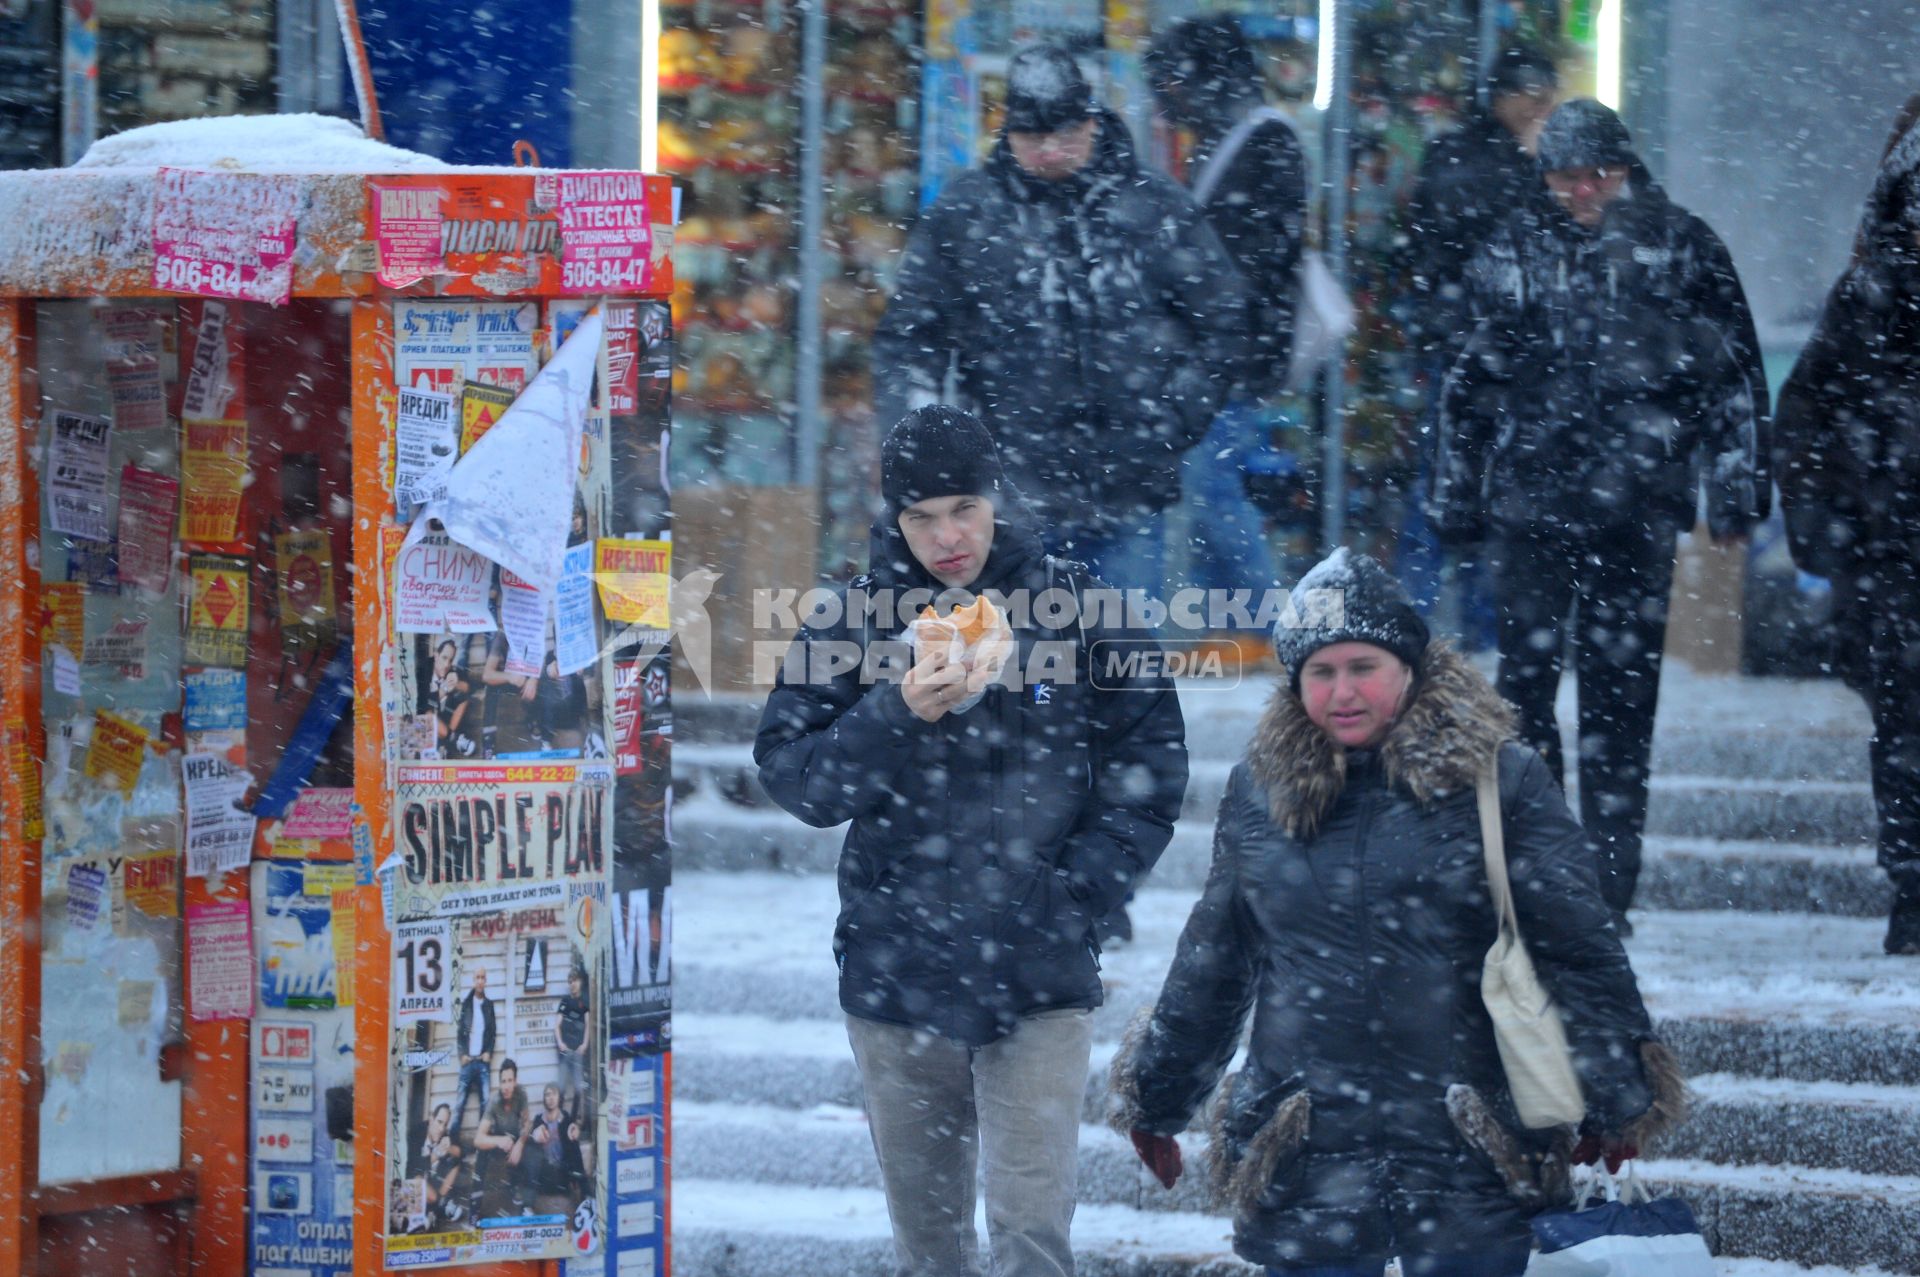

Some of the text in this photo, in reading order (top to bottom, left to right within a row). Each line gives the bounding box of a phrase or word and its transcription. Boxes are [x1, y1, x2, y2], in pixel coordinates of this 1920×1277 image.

[560, 175, 643, 207] ДИПЛОМ
[562, 205, 644, 228] АТТЕСТАТ
[563, 258, 646, 288] 506-84-47
[400, 394, 450, 421] КРЕДИТ
[403, 546, 489, 584] СНИМУ
[602, 548, 667, 575] КРЕДИТ
[401, 576, 457, 595] квартиру
[506, 767, 575, 781] 644-22-22
[402, 793, 535, 885] SIMPLE
[546, 787, 605, 879] PLAN
[463, 895, 488, 907] YOUR
[490, 890, 516, 904] HEART
[539, 884, 562, 896] TOUR
[398, 924, 445, 938] ПЯТНИЦА
[511, 908, 557, 931] АРЕНА
[397, 938, 443, 995] 13
[400, 996, 444, 1010] АПРЕЛЯ
[288, 1084, 311, 1098] ЖКУ
